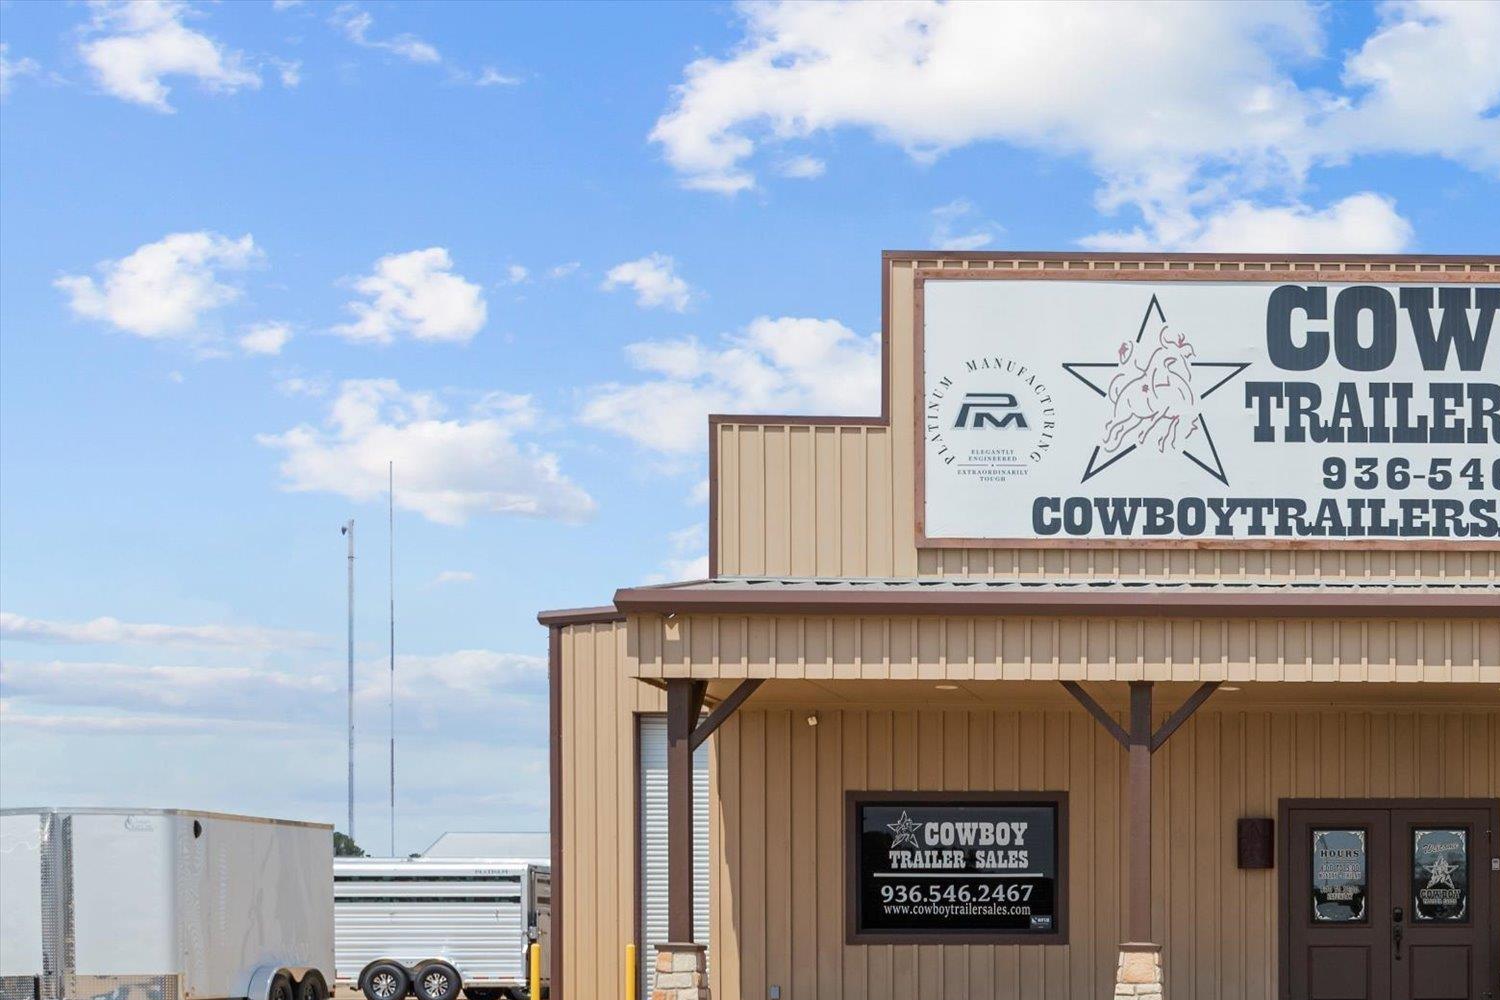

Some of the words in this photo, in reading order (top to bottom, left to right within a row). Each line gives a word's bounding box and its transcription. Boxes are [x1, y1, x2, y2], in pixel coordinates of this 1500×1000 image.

[927, 376, 955, 465] PLATINUM
[966, 357, 1055, 463] MANUFACTURING
[924, 822, 1029, 846] COWBOY
[889, 850, 966, 869] TRAILER
[975, 850, 1029, 869] SALES
[1320, 850, 1360, 858] HOURS
[880, 884, 1034, 903] 936.546.2467
[884, 903, 1031, 918] www.cowboytrailersales.com
